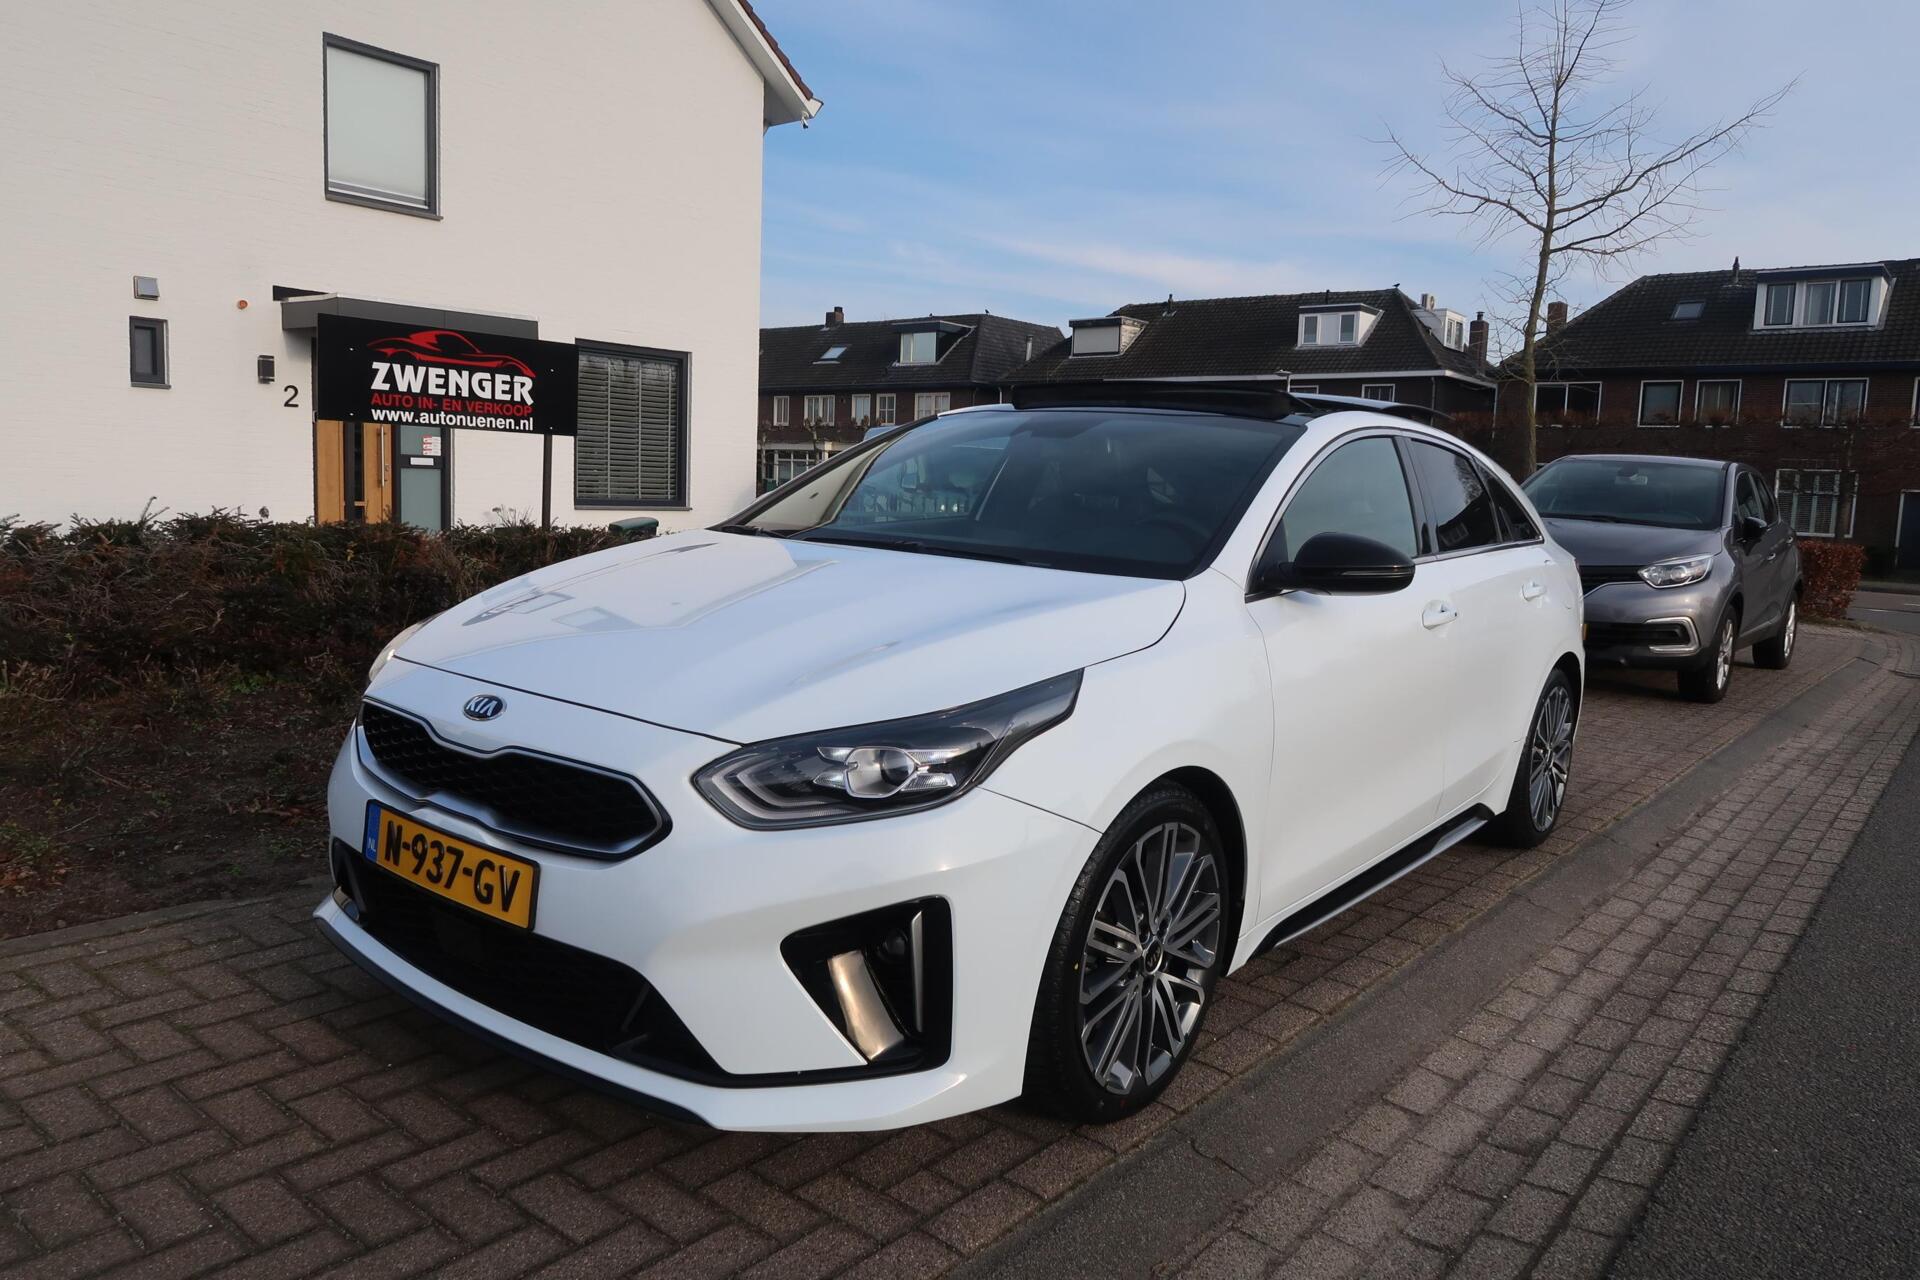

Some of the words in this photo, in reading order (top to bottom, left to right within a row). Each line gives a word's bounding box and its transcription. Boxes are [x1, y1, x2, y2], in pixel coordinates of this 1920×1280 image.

[371, 361, 534, 405] ZWENGER
[283, 385, 299, 408] 2
[371, 393, 414, 408] AUTO
[418, 396, 438, 410] IN-
[443, 399, 463, 412] EN
[466, 401, 533, 417] VERKOOP
[371, 408, 534, 431] www.autonuenen.nl
[465, 696, 498, 716] KIA
[384, 820, 521, 912] N-937-GV
